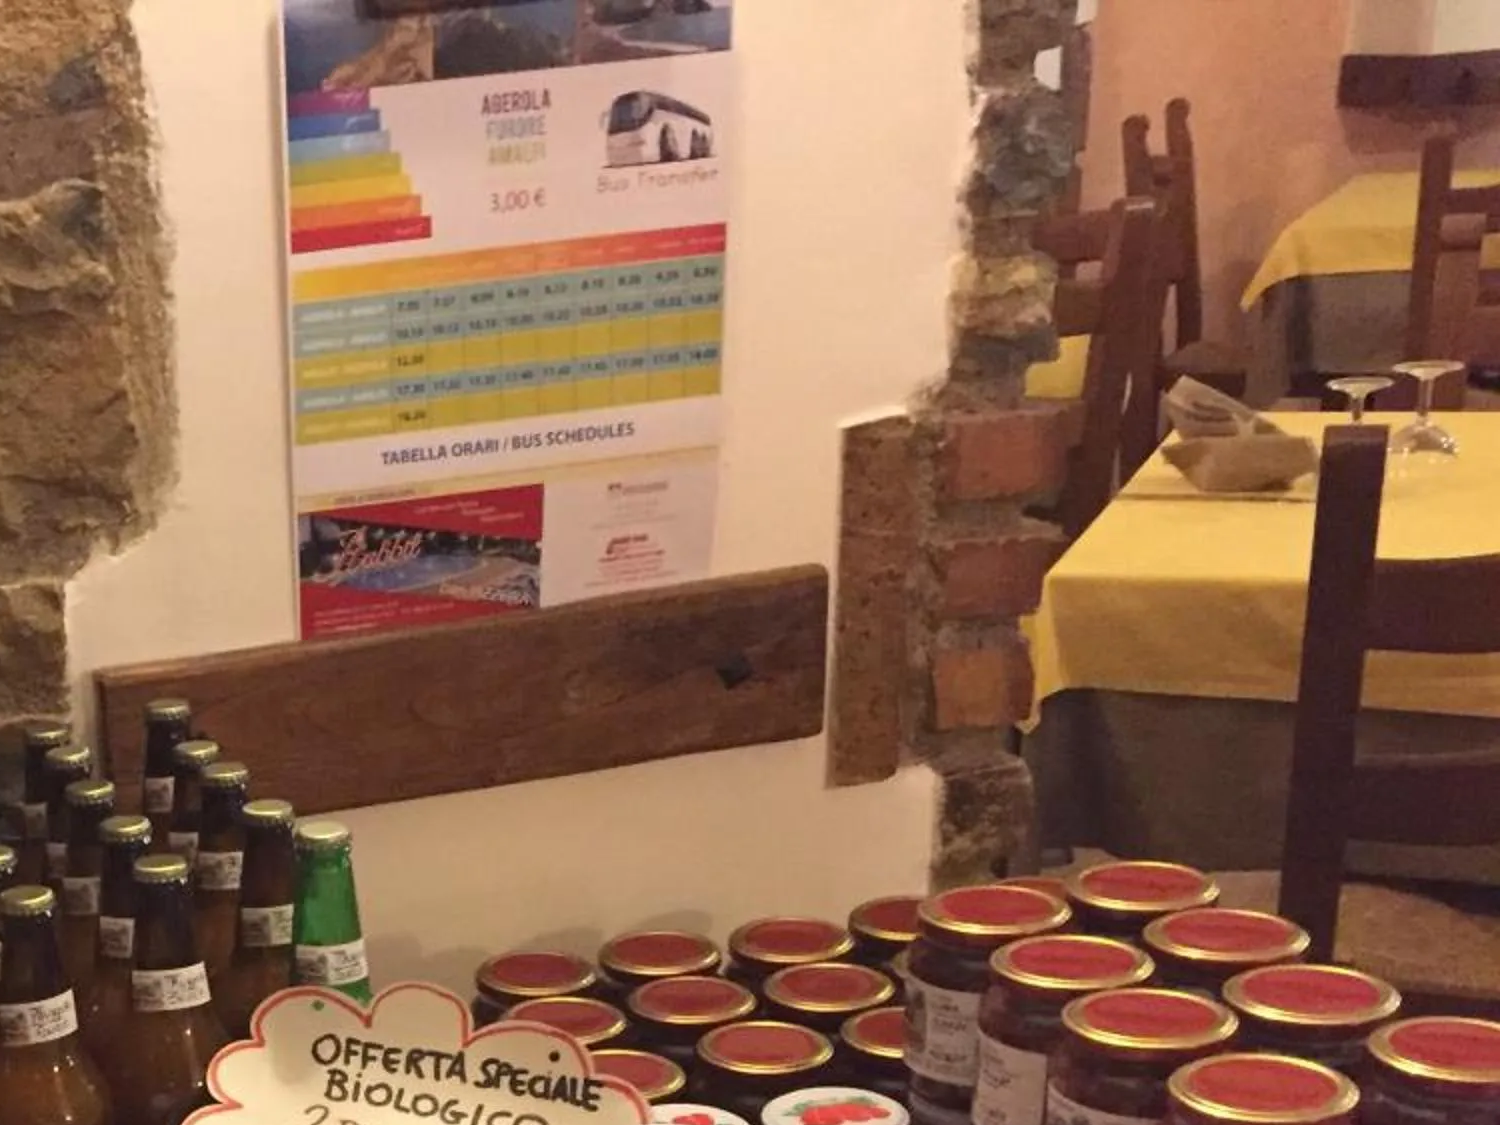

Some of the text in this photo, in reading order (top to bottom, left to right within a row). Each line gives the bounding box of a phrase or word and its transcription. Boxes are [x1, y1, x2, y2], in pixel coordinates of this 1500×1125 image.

[481, 88, 551, 116] AGEROLA
[597, 168, 718, 193] Bus Transfer
[381, 445, 448, 466] TABELLA
[451, 440, 499, 458] ORARI
[511, 432, 542, 451] BUS
[546, 421, 636, 446] SCHEDULES
[311, 1033, 604, 1113] OFFERTA SPECIALE
